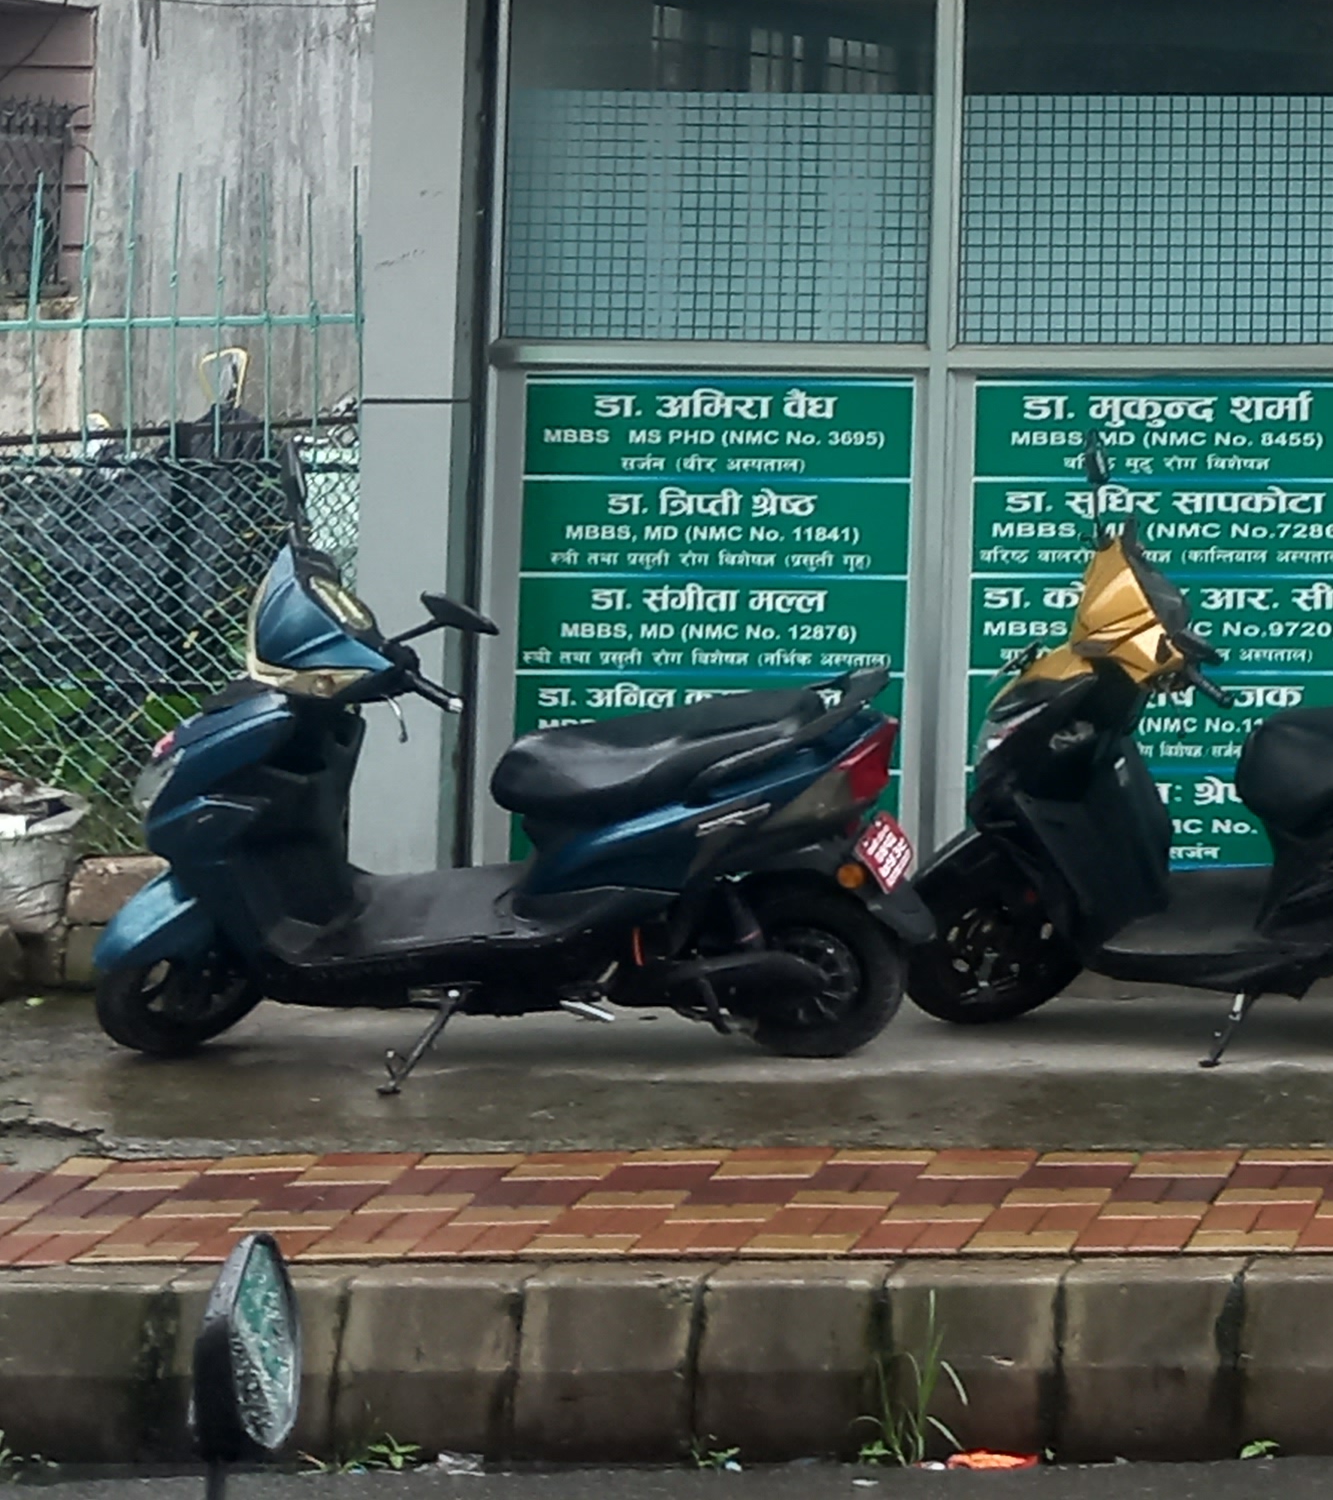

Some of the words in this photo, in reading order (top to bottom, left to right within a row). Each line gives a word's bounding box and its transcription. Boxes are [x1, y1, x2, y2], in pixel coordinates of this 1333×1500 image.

[1023, 395, 1075, 421] डा.
[1088, 395, 1218, 429] मुकुन्द
[1229, 390, 1314, 424] शर्मा
[608, 493, 648, 515] डा.
[659, 486, 744, 517] त्रिप्ती
[751, 487, 818, 518] श्रेष्ठ
[565, 524, 637, 543] MBBS,
[644, 525, 679, 541] MD
[684, 525, 743, 544] (NMC
[749, 525, 785, 542] No.
